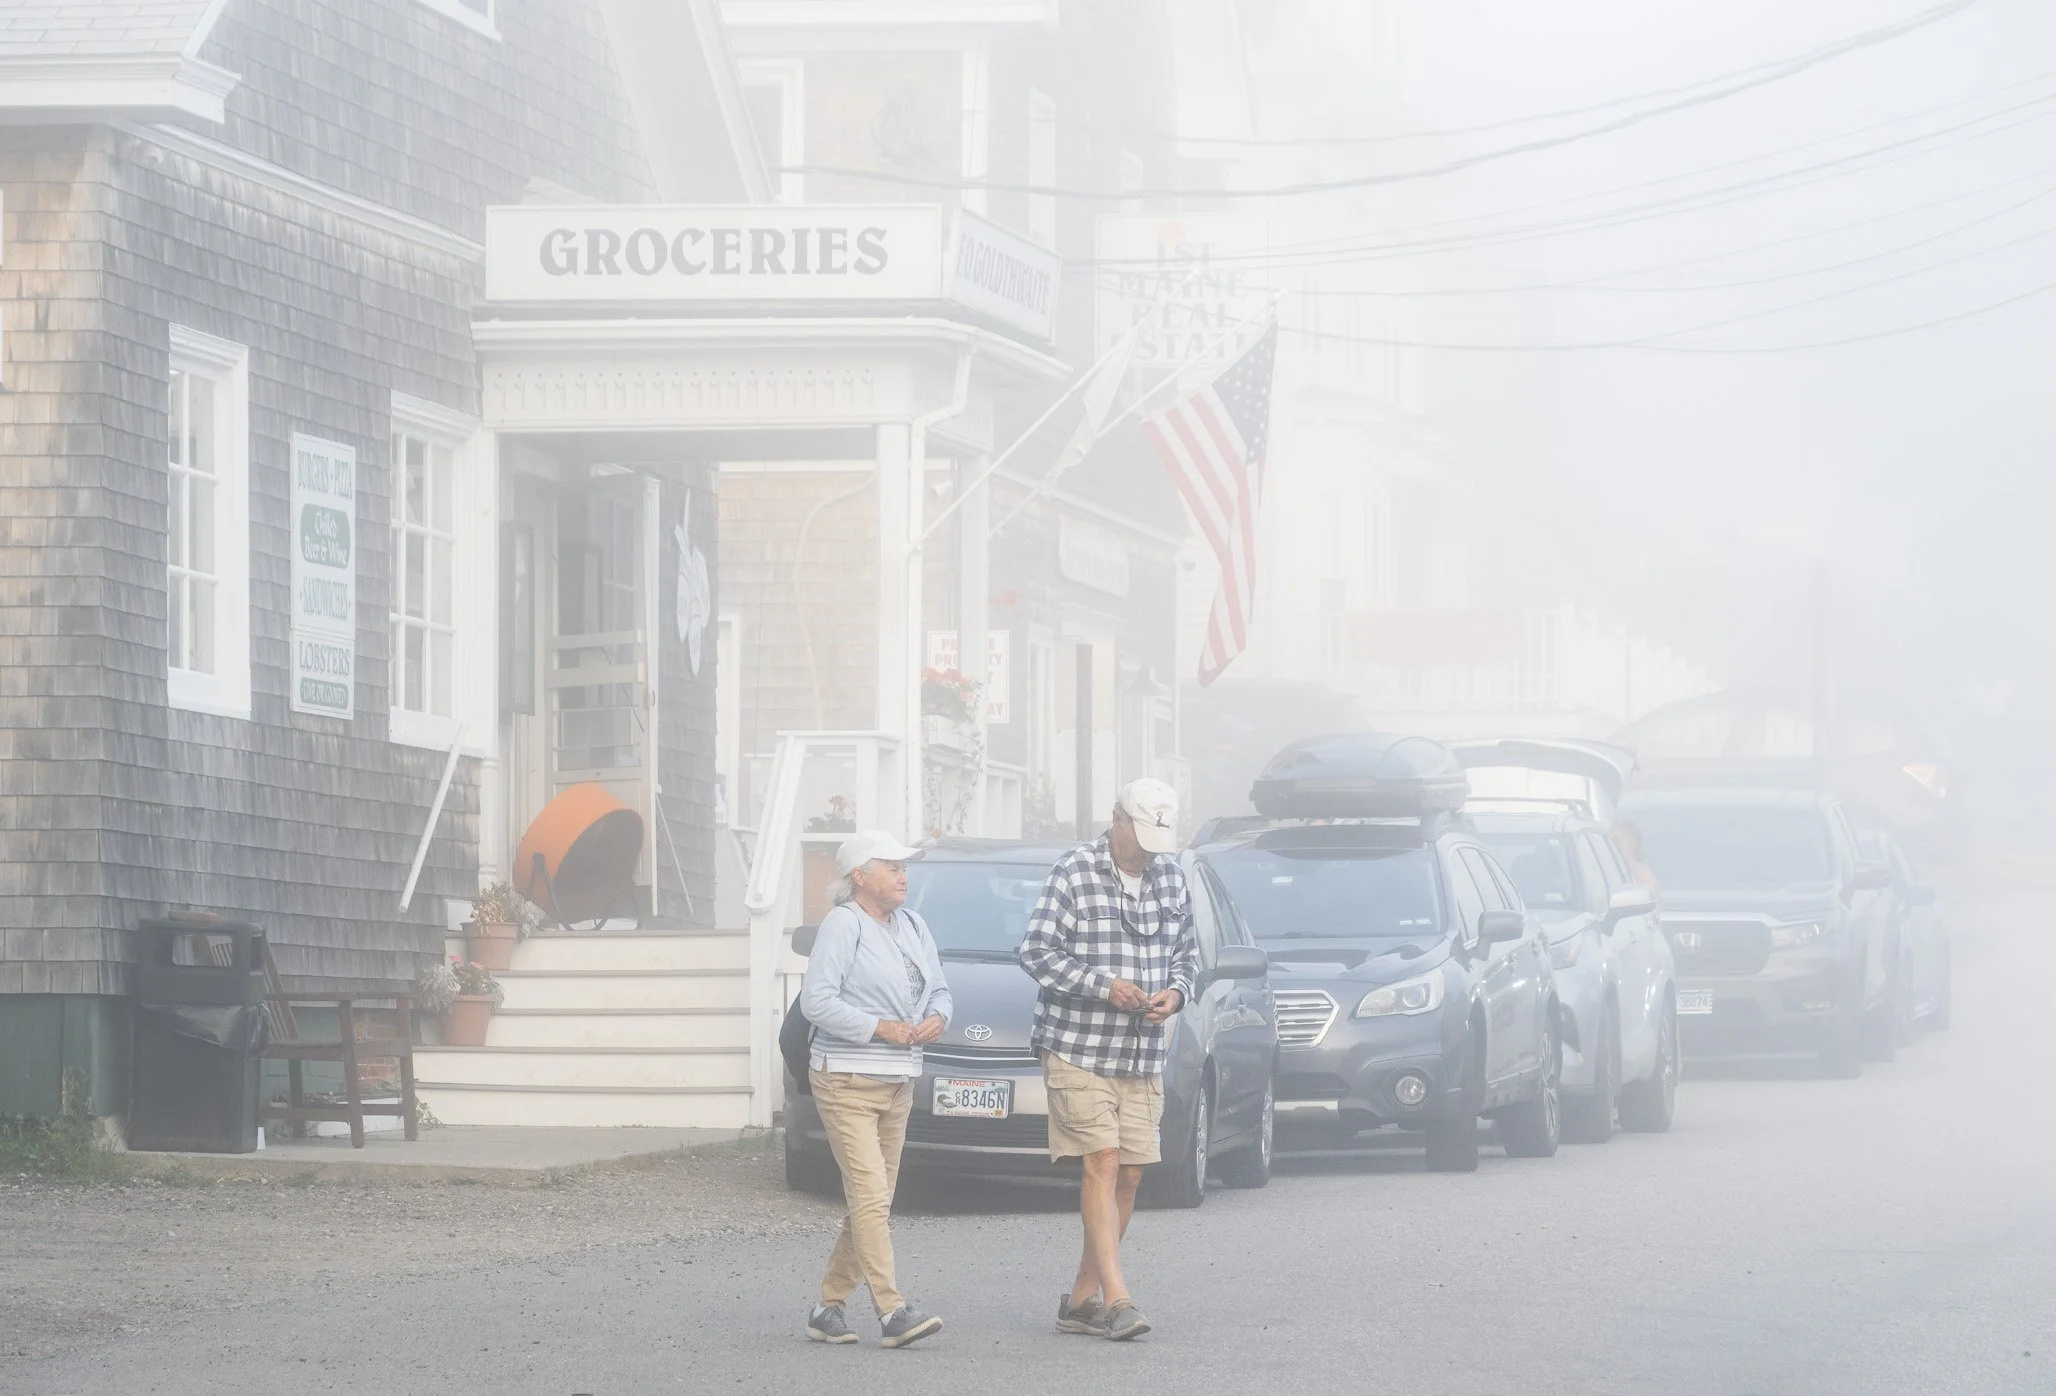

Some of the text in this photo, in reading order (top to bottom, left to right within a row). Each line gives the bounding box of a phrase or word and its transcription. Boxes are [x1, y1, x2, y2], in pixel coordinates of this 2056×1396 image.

[540, 226, 889, 276] GROCERIES
[1118, 270, 1247, 300] MAINE
[1131, 302, 1235, 330] REAL
[300, 640, 350, 677] LOBSTERS
[952, 1080, 986, 1088] MAINE
[961, 1089, 1005, 1110] 8346N
